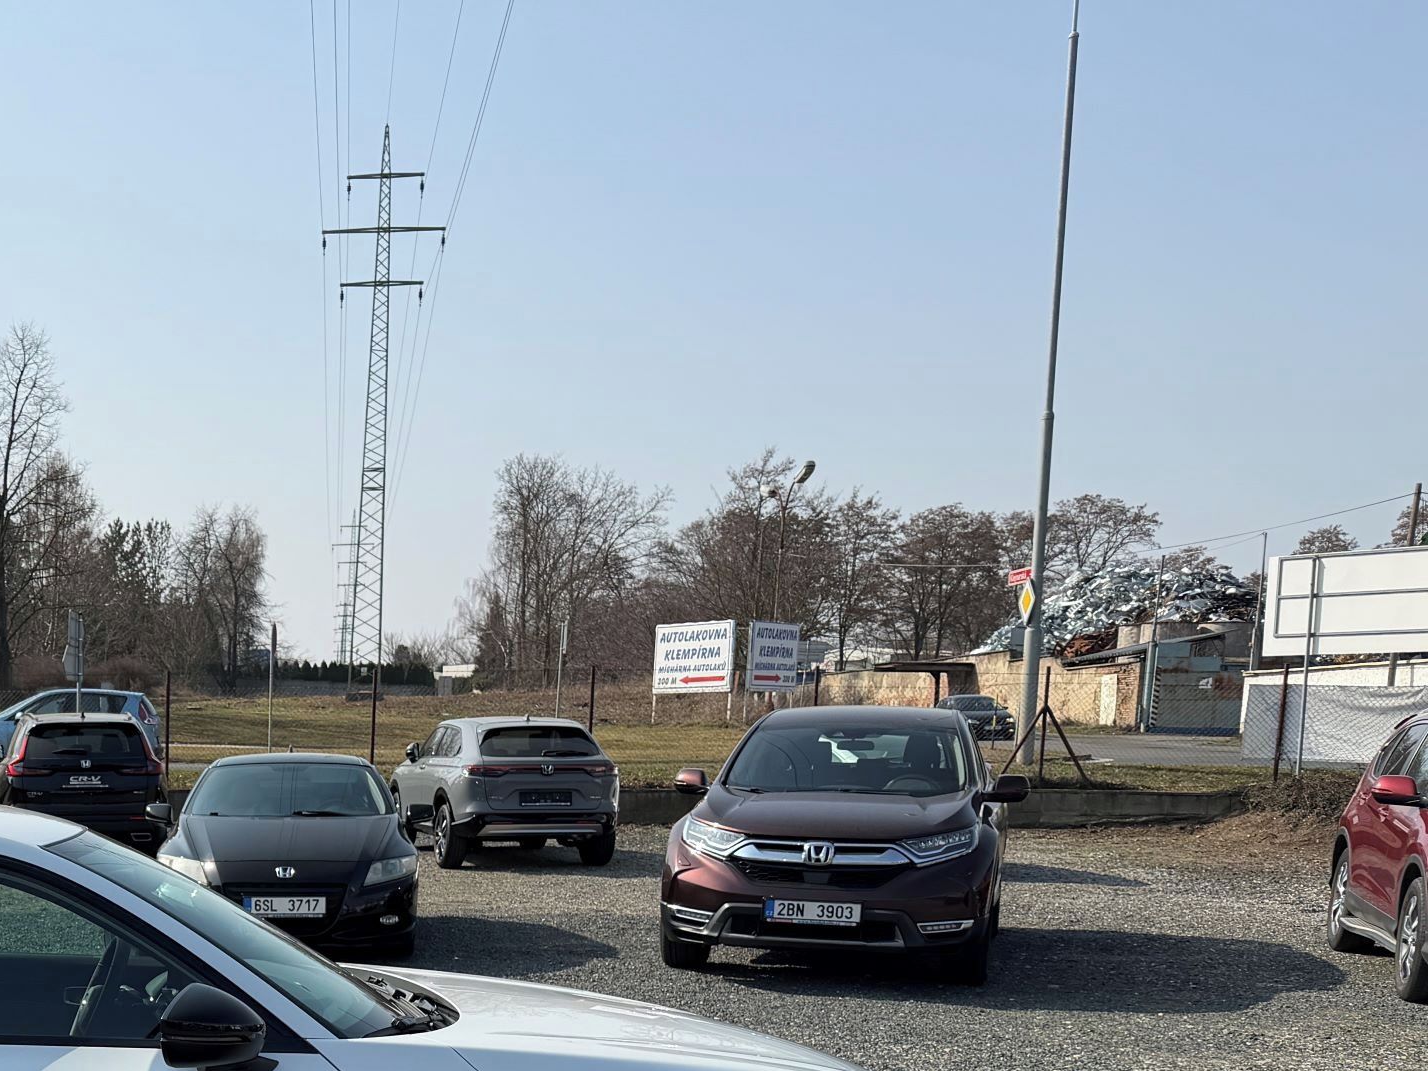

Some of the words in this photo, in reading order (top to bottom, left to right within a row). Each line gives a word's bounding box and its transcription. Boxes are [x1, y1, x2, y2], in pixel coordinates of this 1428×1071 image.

[660, 627, 728, 644] AUTOLAKOVNA
[756, 627, 798, 641] AUTOLAKOVNA
[664, 645, 721, 662] KLEMPÍRNA
[759, 644, 794, 659] KLEMPÍRNA
[693, 661, 727, 672] AUTOLAKŮ
[254, 898, 277, 912] 6SL
[288, 898, 320, 912] 3717
[777, 902, 805, 917] 2BN
[816, 904, 854, 920] 3903
